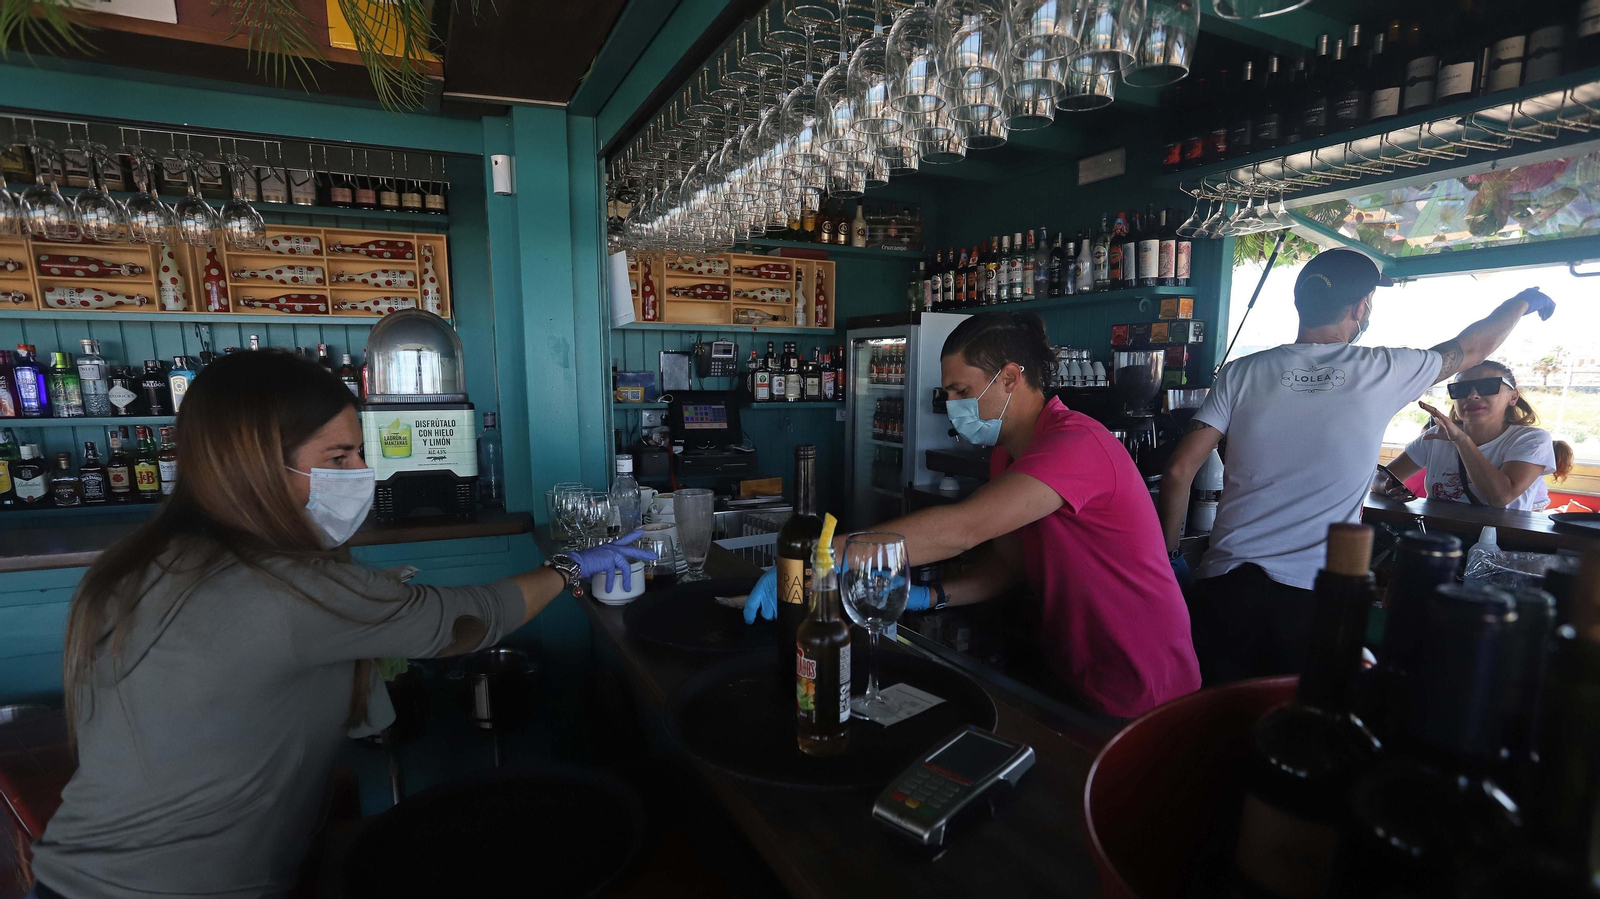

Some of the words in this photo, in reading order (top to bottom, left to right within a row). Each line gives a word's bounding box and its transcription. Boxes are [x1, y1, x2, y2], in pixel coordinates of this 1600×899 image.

[1294, 374, 1331, 382] LOLEA
[415, 418, 456, 428] DISFRÚTALO
[418, 429, 433, 437] CON
[434, 429, 454, 437] HIELO
[429, 436, 451, 446] LIMÓN
[138, 470, 155, 485] J&B
